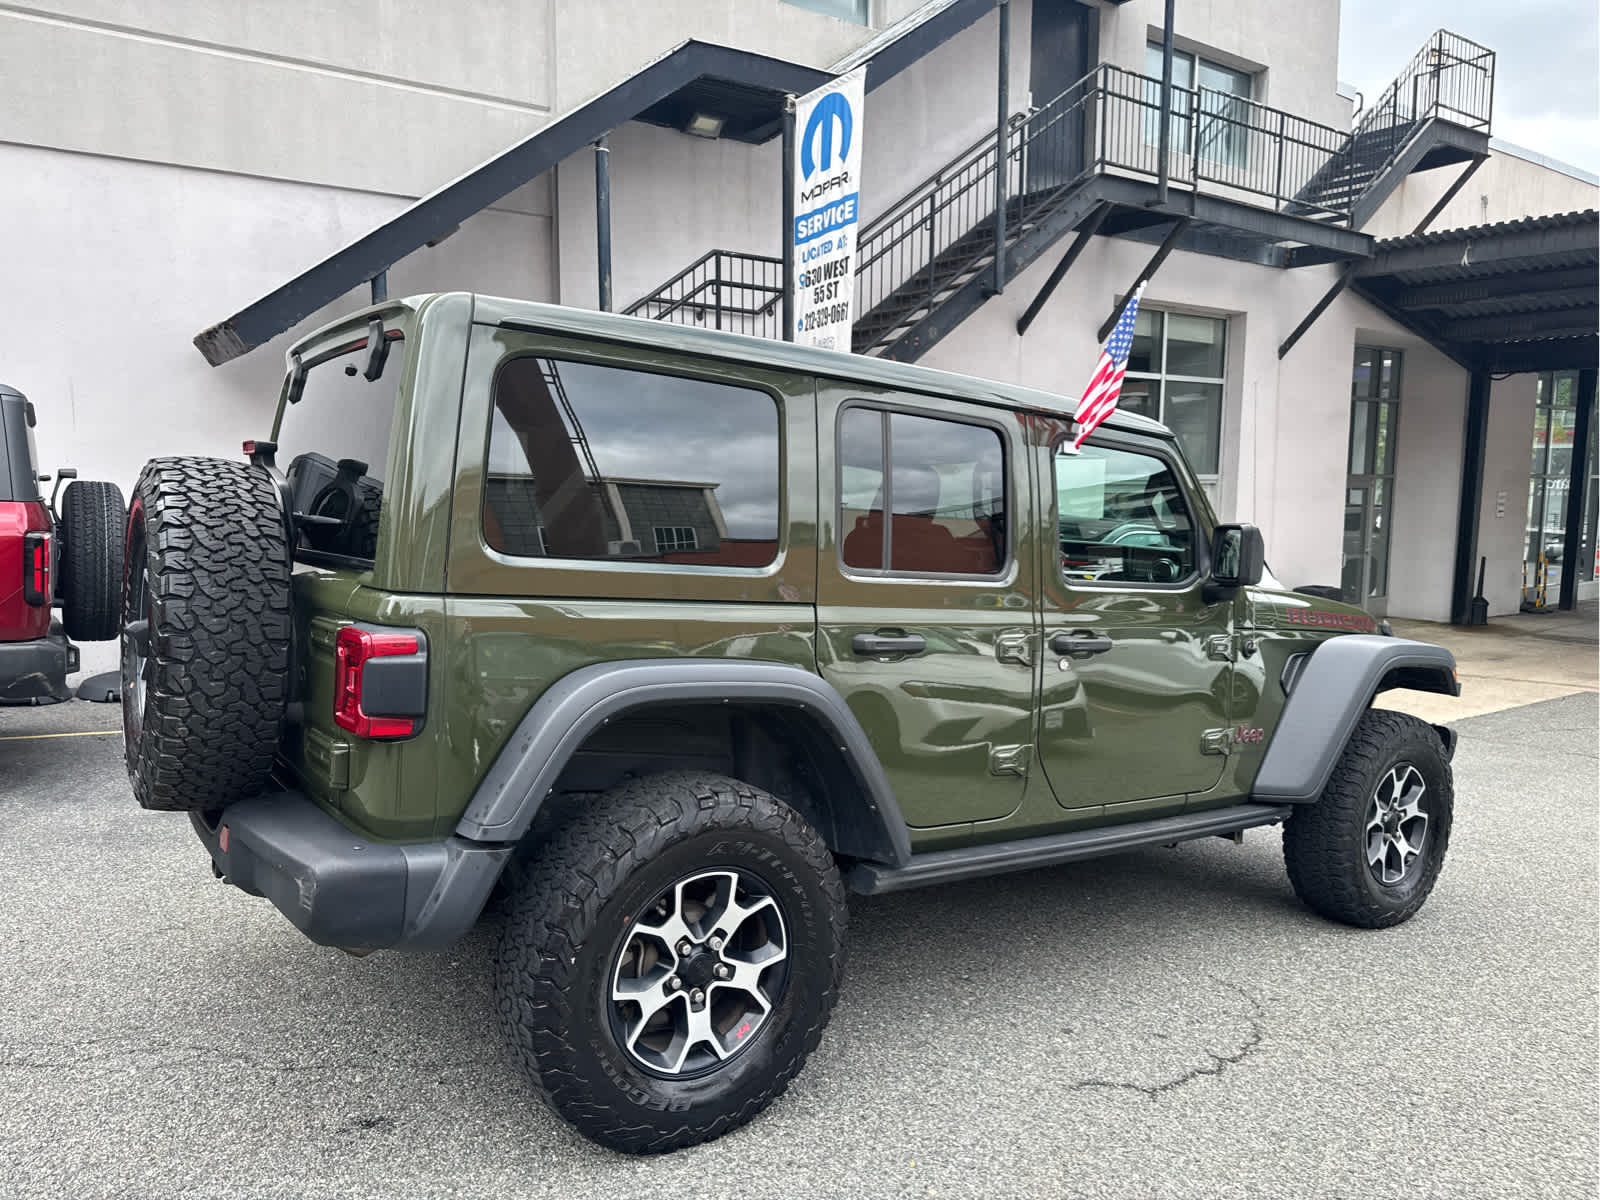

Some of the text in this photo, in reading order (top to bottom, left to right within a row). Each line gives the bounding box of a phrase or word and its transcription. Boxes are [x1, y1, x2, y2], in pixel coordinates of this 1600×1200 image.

[801, 171, 849, 203] MOPAR
[797, 199, 855, 239] SERVICE
[802, 240, 833, 264] LOCATED
[805, 255, 850, 288] 630 WEST
[813, 280, 840, 305] 55 ST
[1233, 725, 1264, 745] Jeep
